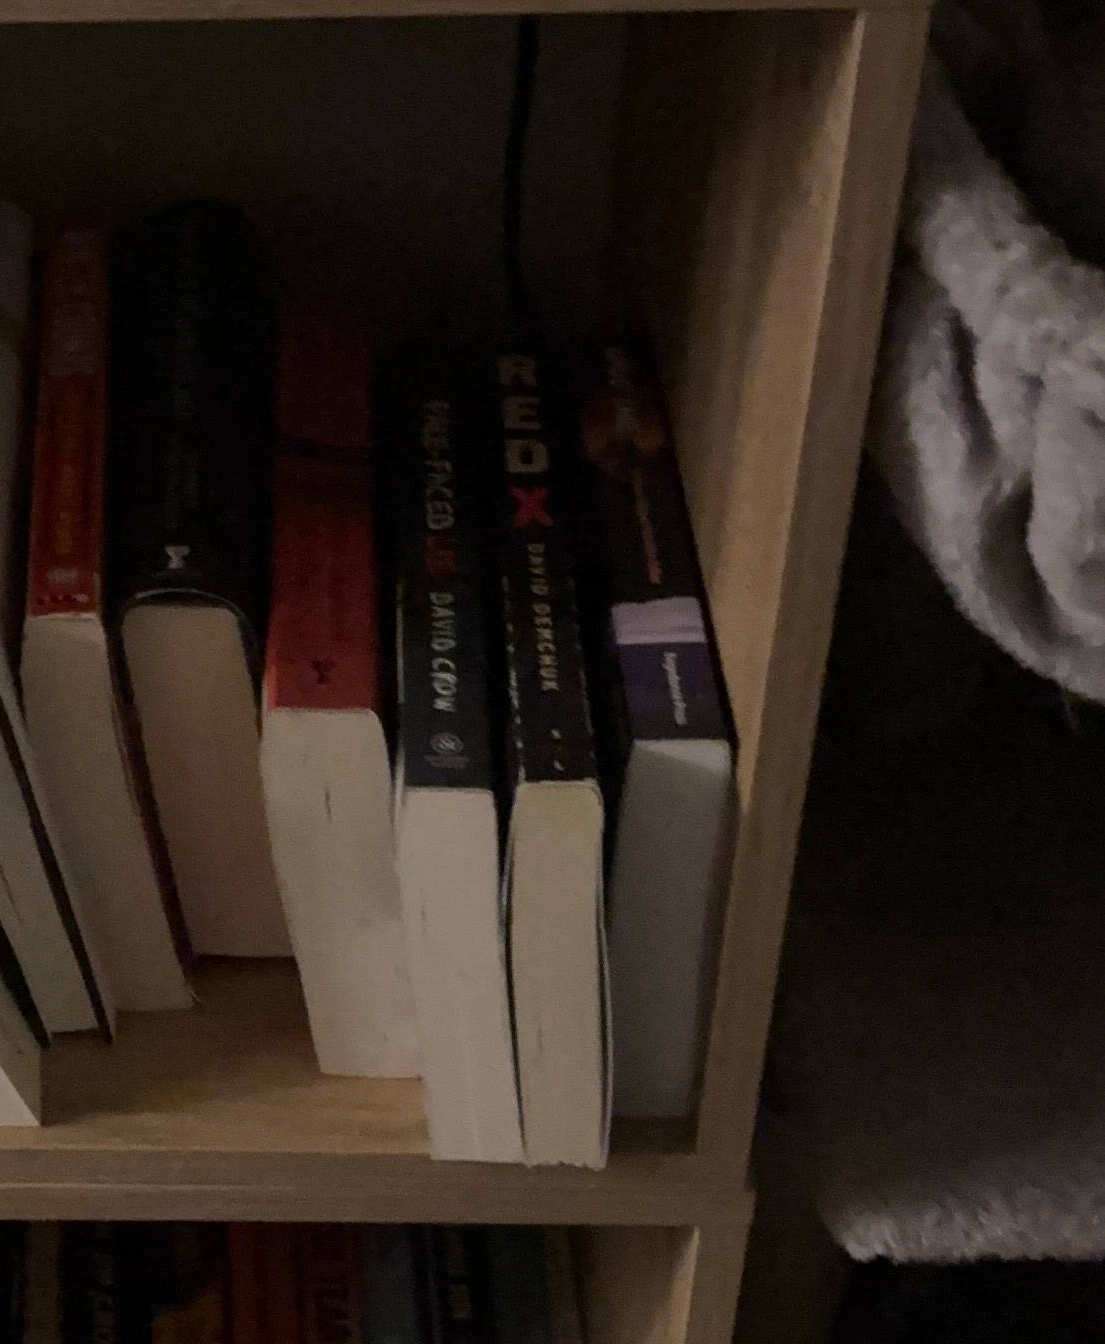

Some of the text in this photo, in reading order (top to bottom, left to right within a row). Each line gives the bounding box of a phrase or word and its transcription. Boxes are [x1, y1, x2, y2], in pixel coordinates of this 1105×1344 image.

[497, 354, 555, 529] RED X
[526, 542, 549, 596] DAVID
[428, 591, 456, 651] DAVID
